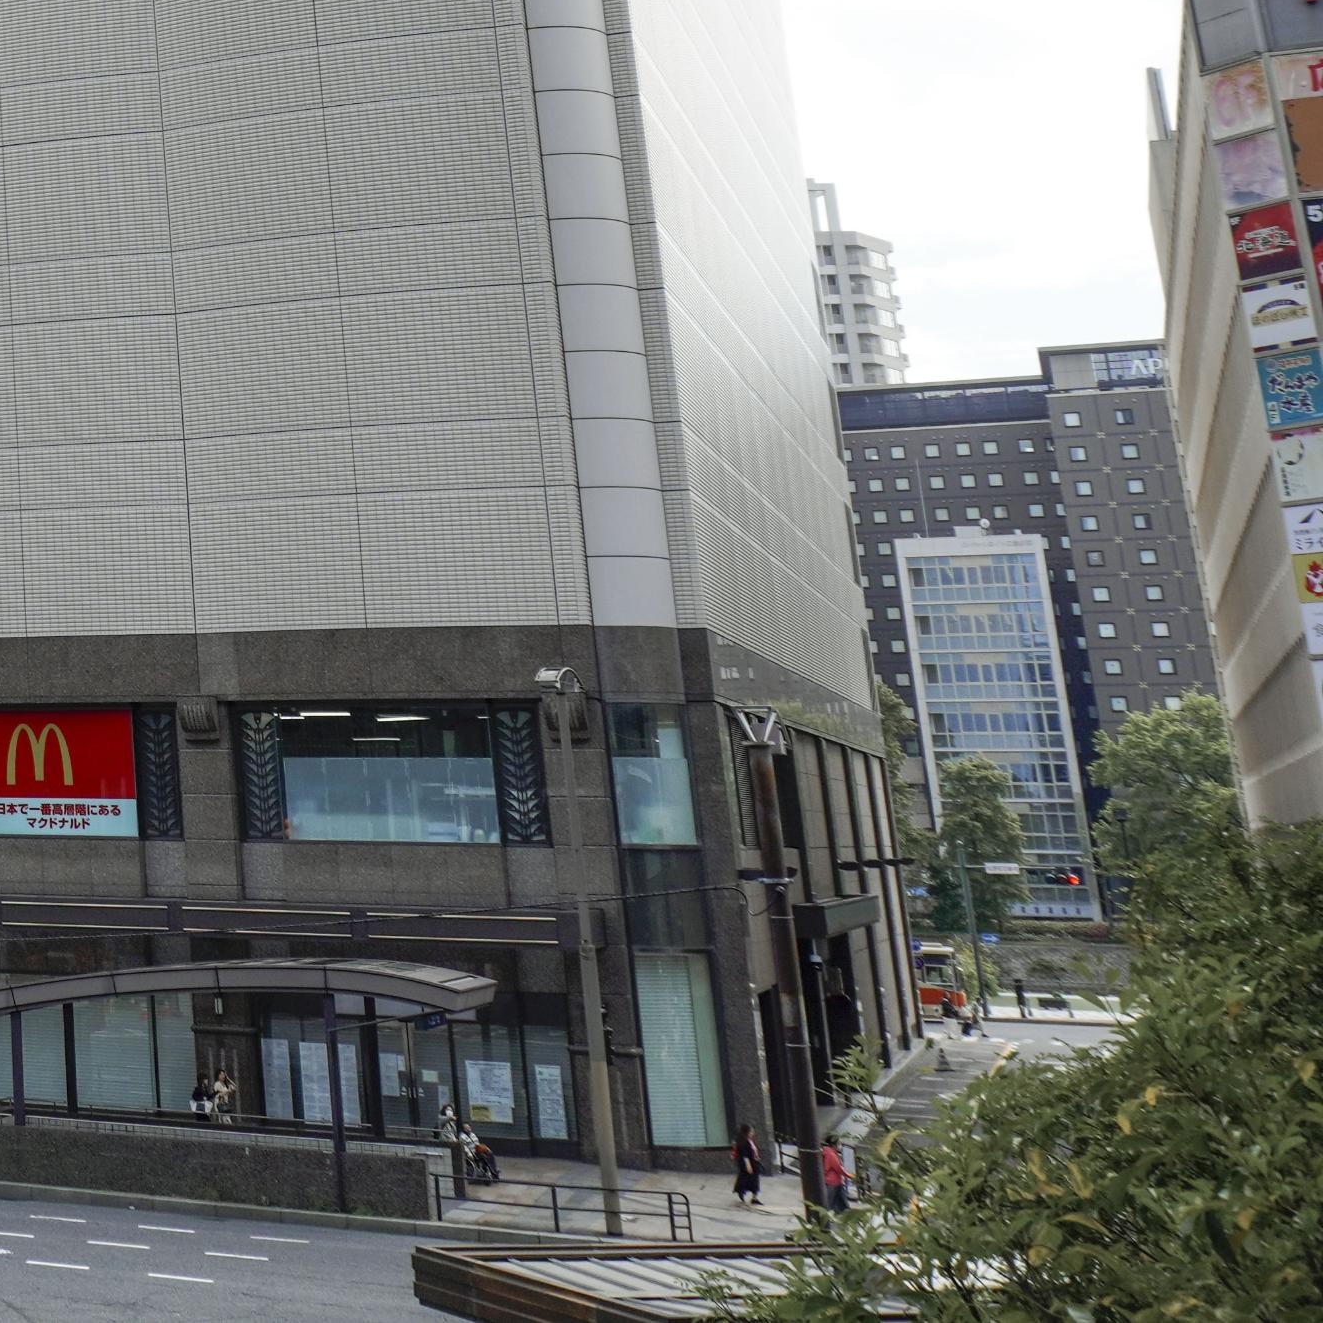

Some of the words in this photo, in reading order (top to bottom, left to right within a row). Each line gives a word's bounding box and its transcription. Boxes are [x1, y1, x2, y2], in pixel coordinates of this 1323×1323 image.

[27, 818, 90, 829] マクドナルド
